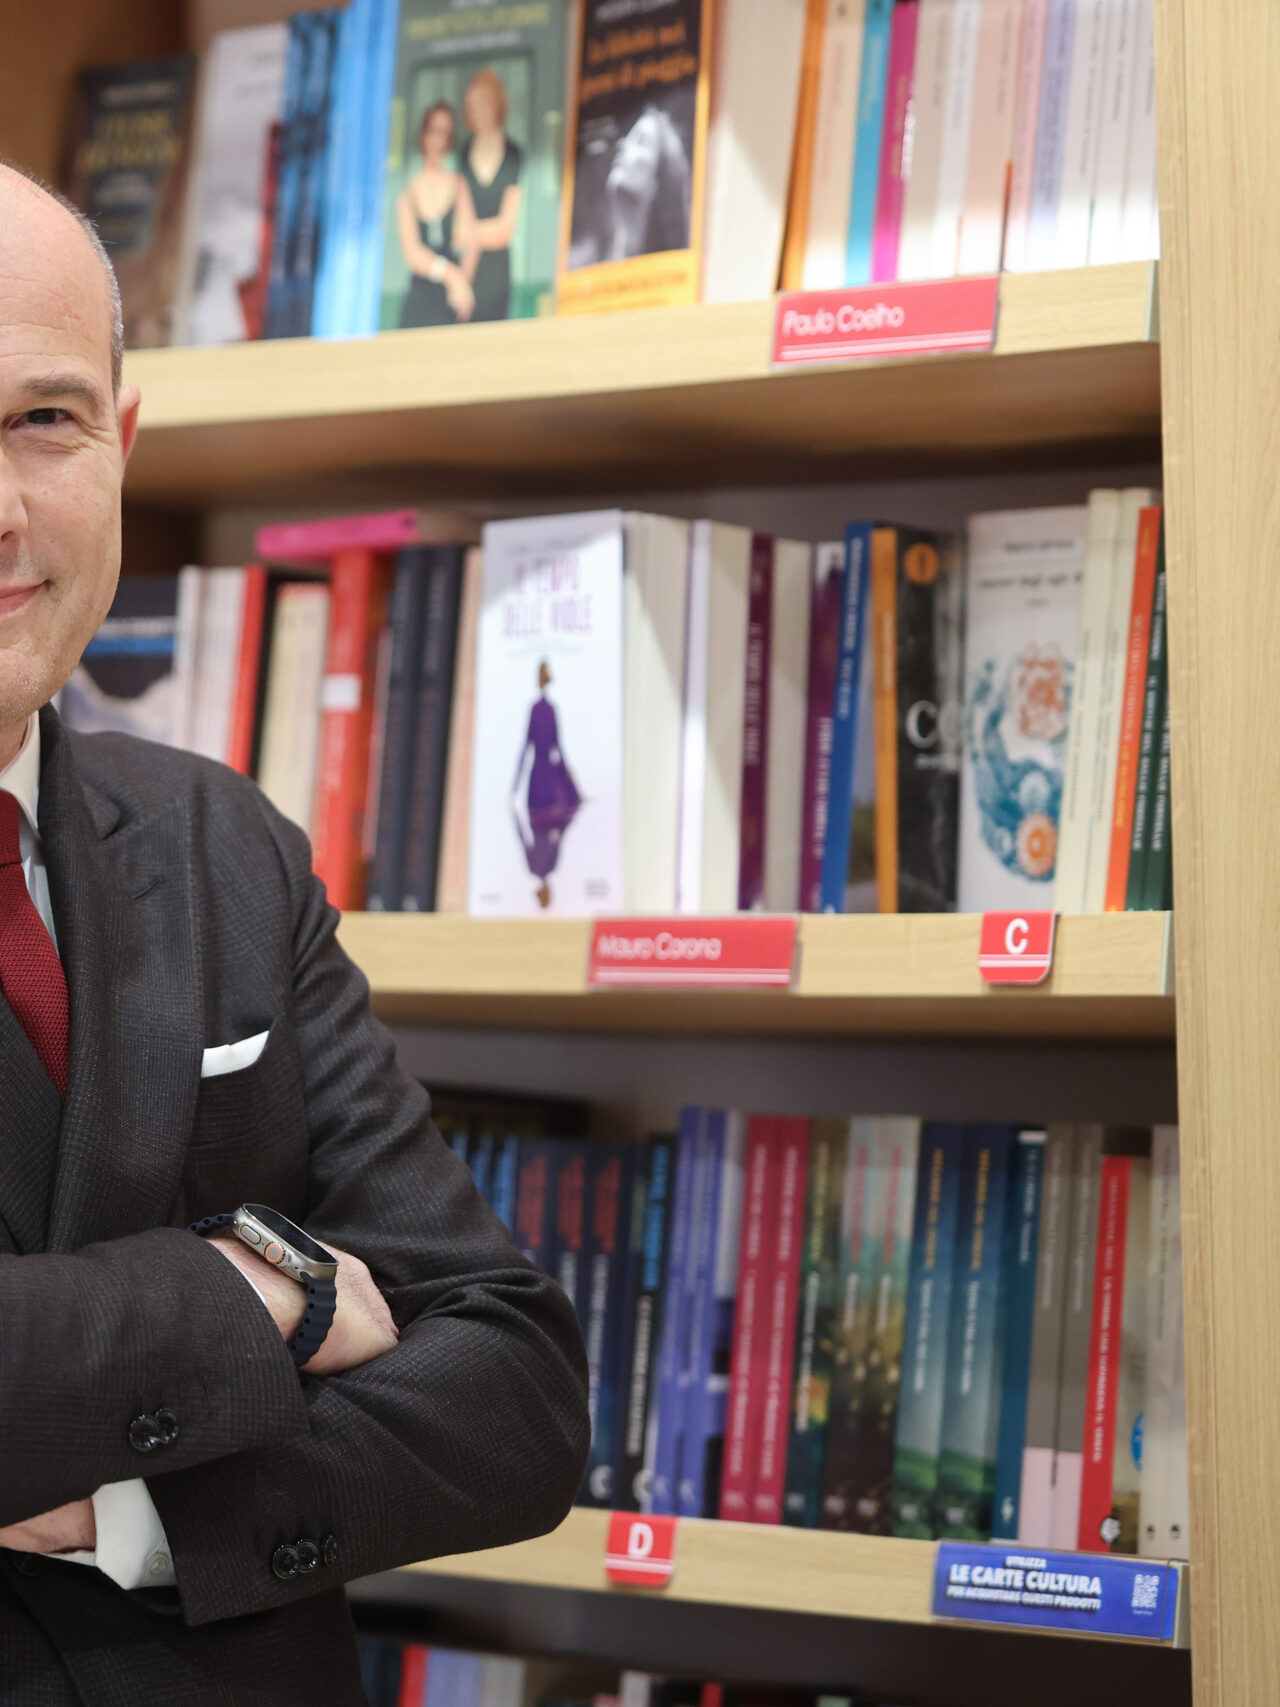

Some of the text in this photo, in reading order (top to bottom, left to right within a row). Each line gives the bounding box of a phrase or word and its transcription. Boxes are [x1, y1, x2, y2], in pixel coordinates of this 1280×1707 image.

[783, 302, 905, 337] Paulo Coelho
[597, 932, 722, 960] Mauro Corona
[1005, 918, 1029, 954] C
[627, 1522, 654, 1559] D
[1005, 1555, 1048, 1569] UTILIZZA
[949, 1564, 1102, 1595] LE CARTE CULTURA
[946, 1585, 1102, 1611] PER ACQUISTARE QUESTI PRODOTTI
